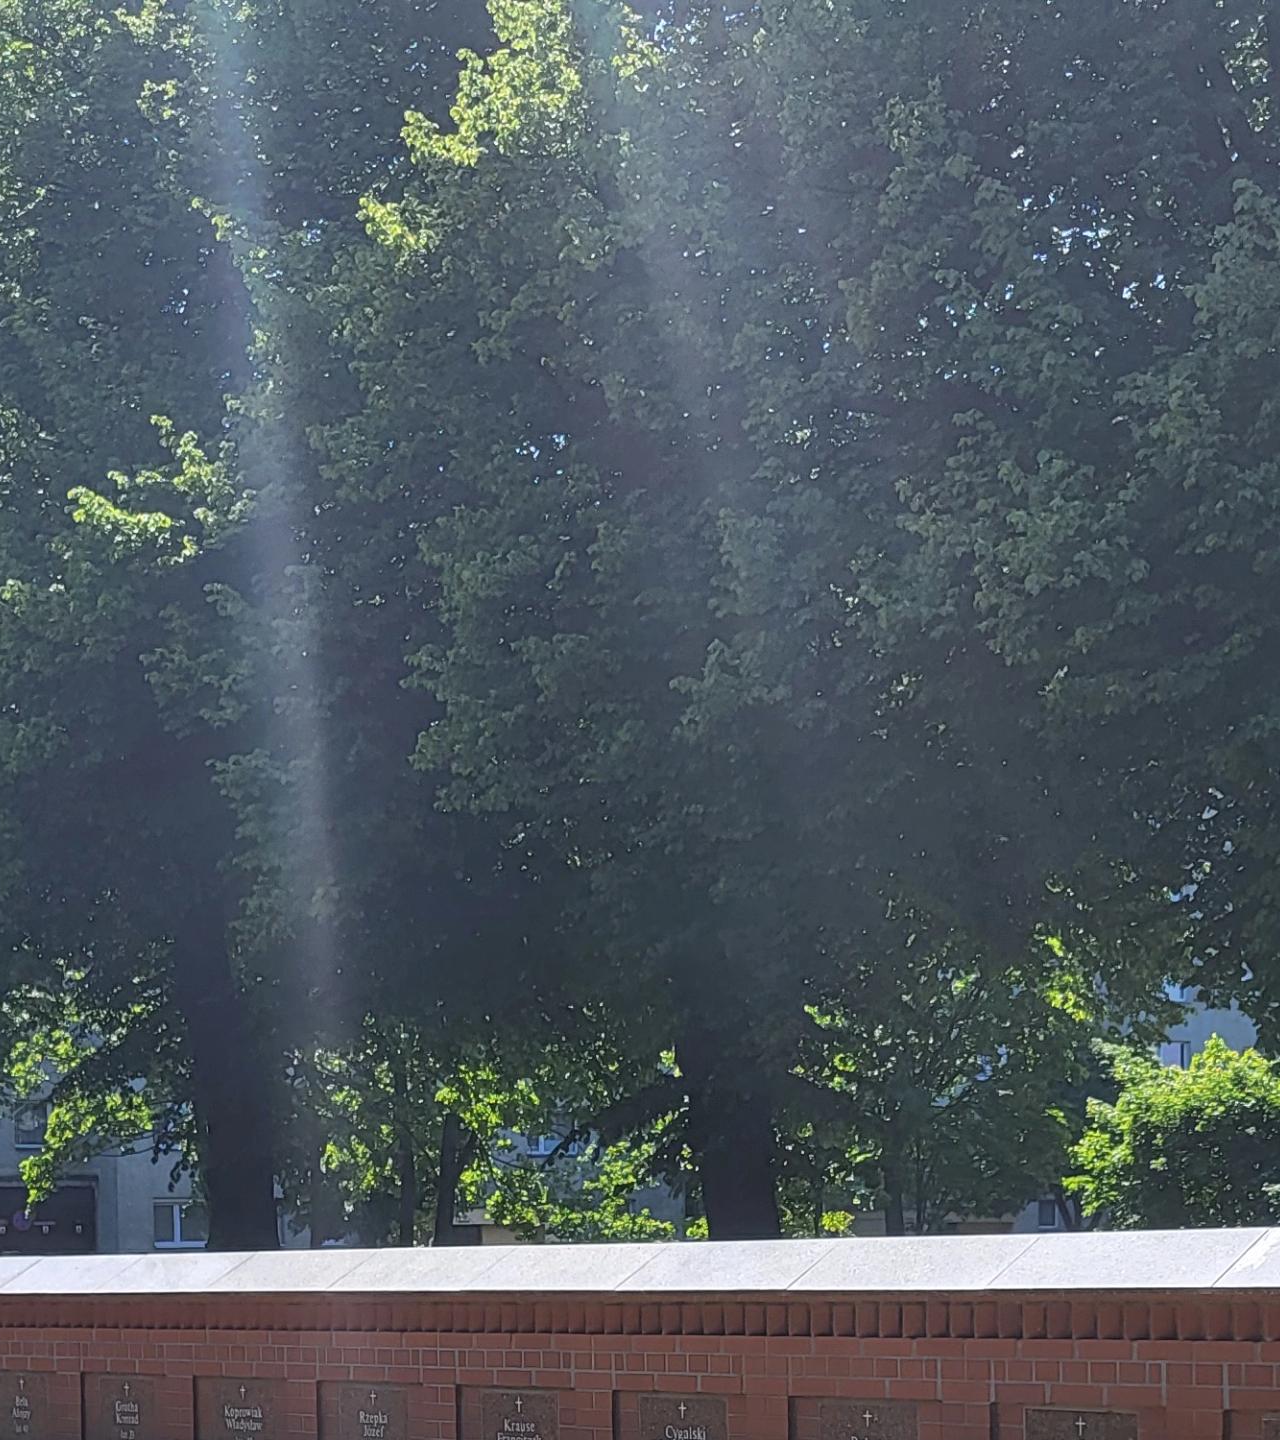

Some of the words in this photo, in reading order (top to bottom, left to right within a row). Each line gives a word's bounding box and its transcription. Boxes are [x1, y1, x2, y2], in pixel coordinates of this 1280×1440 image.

[359, 1410, 388, 1427] Rzepka
[504, 1418, 536, 1432] Krause
[363, 1424, 384, 1438] Józef
